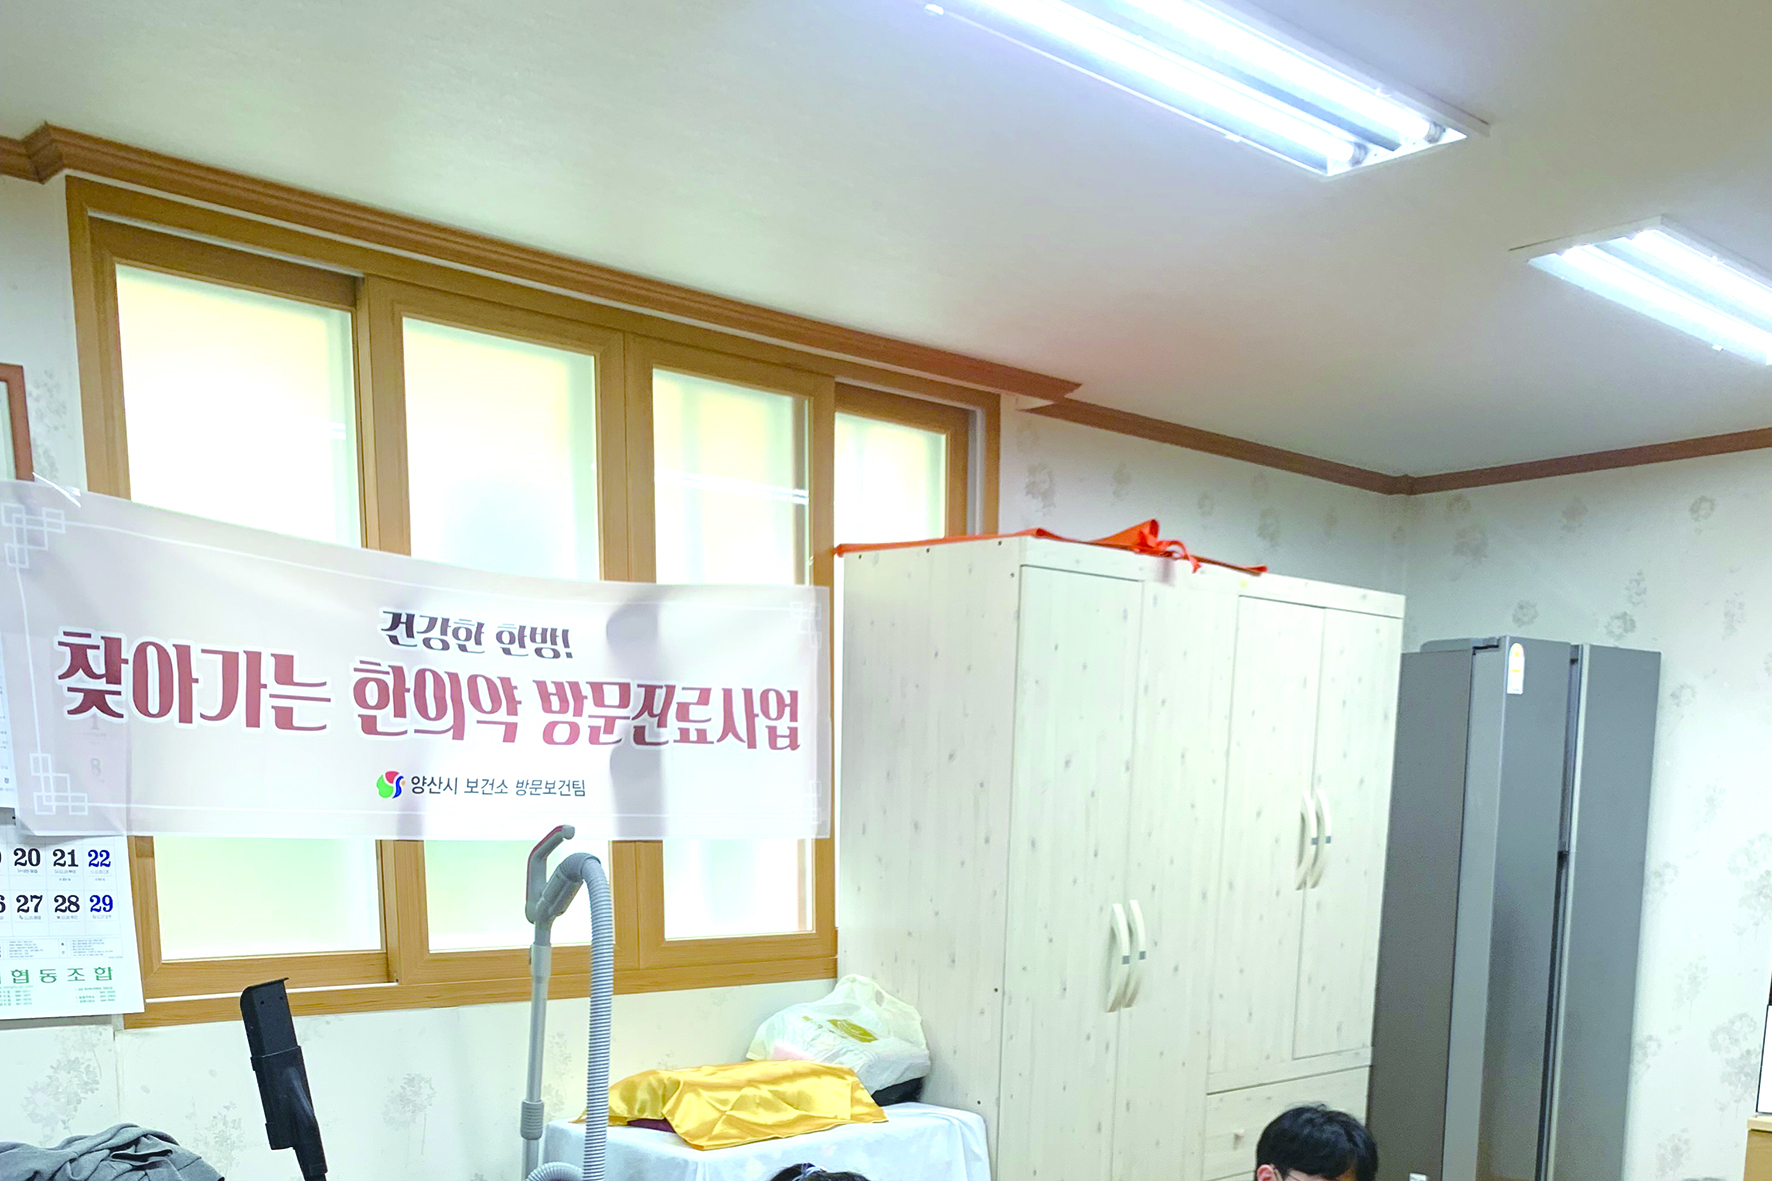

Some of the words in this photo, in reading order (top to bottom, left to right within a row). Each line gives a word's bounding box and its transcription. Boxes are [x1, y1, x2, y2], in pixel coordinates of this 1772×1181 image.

[381, 610, 485, 654] 건강한
[495, 623, 574, 659] 한방!
[58, 630, 332, 732] 찾아가는
[353, 659, 522, 743] 한의약
[532, 679, 801, 751] 방문진료사업
[411, 775, 458, 795] 양산시
[464, 777, 509, 796] 보건소
[515, 778, 586, 797] 방문보건팀
[13, 847, 41, 867] 20
[52, 848, 79, 868] 21
[87, 849, 112, 868] 22
[15, 894, 43, 913] 27
[53, 894, 81, 913] 28
[89, 894, 114, 913] 29
